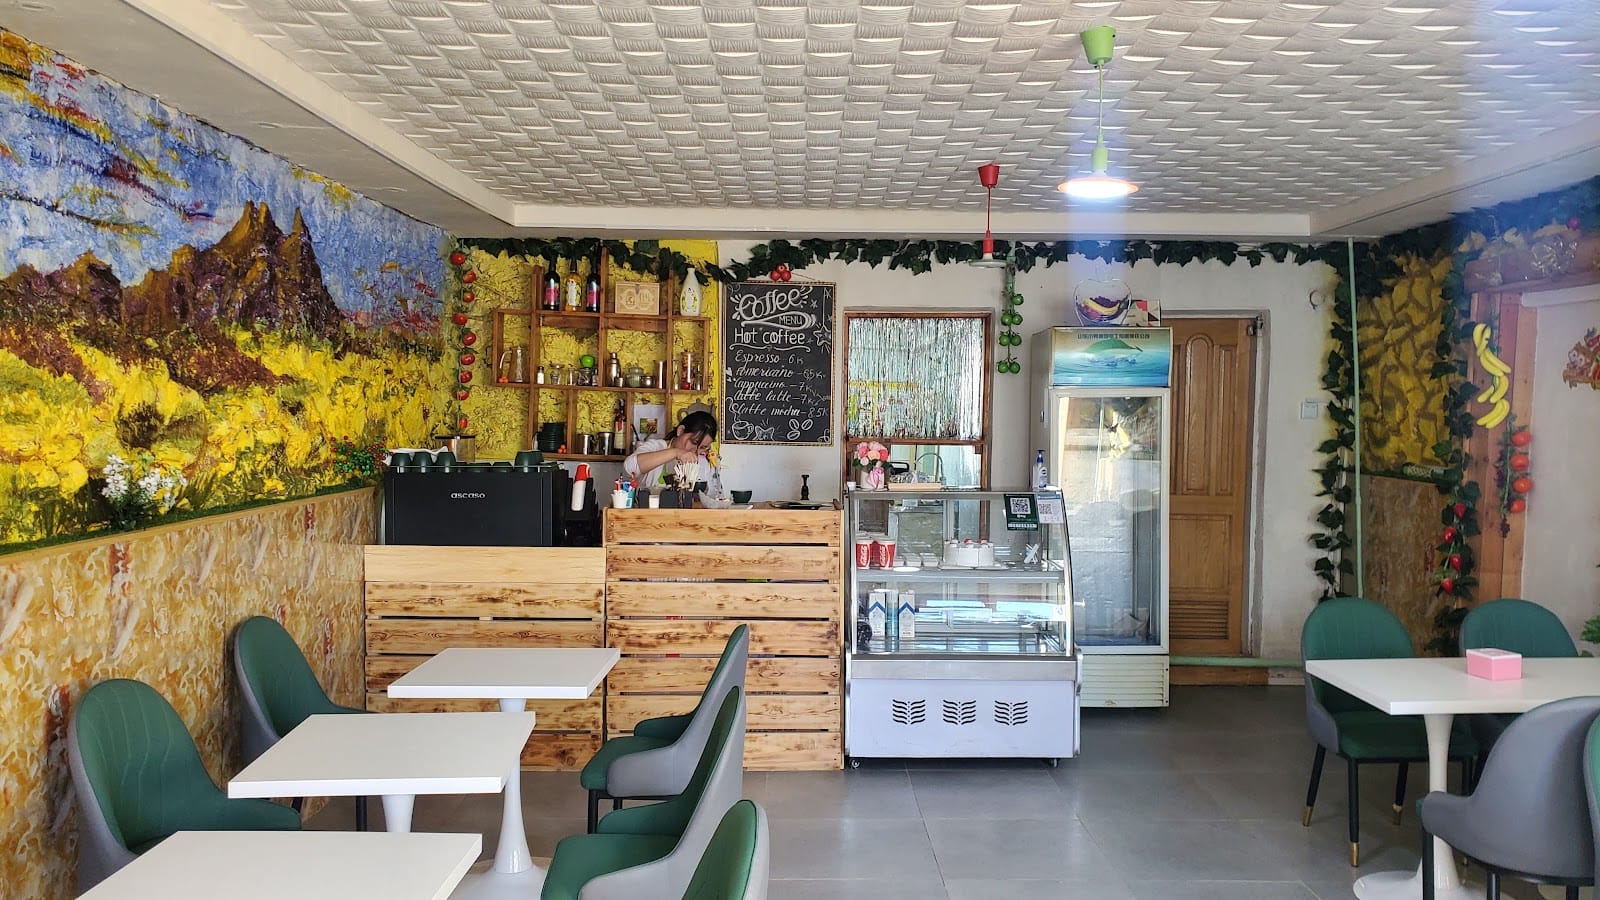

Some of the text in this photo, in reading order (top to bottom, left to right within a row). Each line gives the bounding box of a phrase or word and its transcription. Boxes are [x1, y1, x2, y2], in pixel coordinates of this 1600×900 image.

[738, 287, 804, 320] Coffee
[779, 315, 802, 325] MENU
[734, 327, 806, 344] Hot coffee
[735, 350, 780, 366] Espresso
